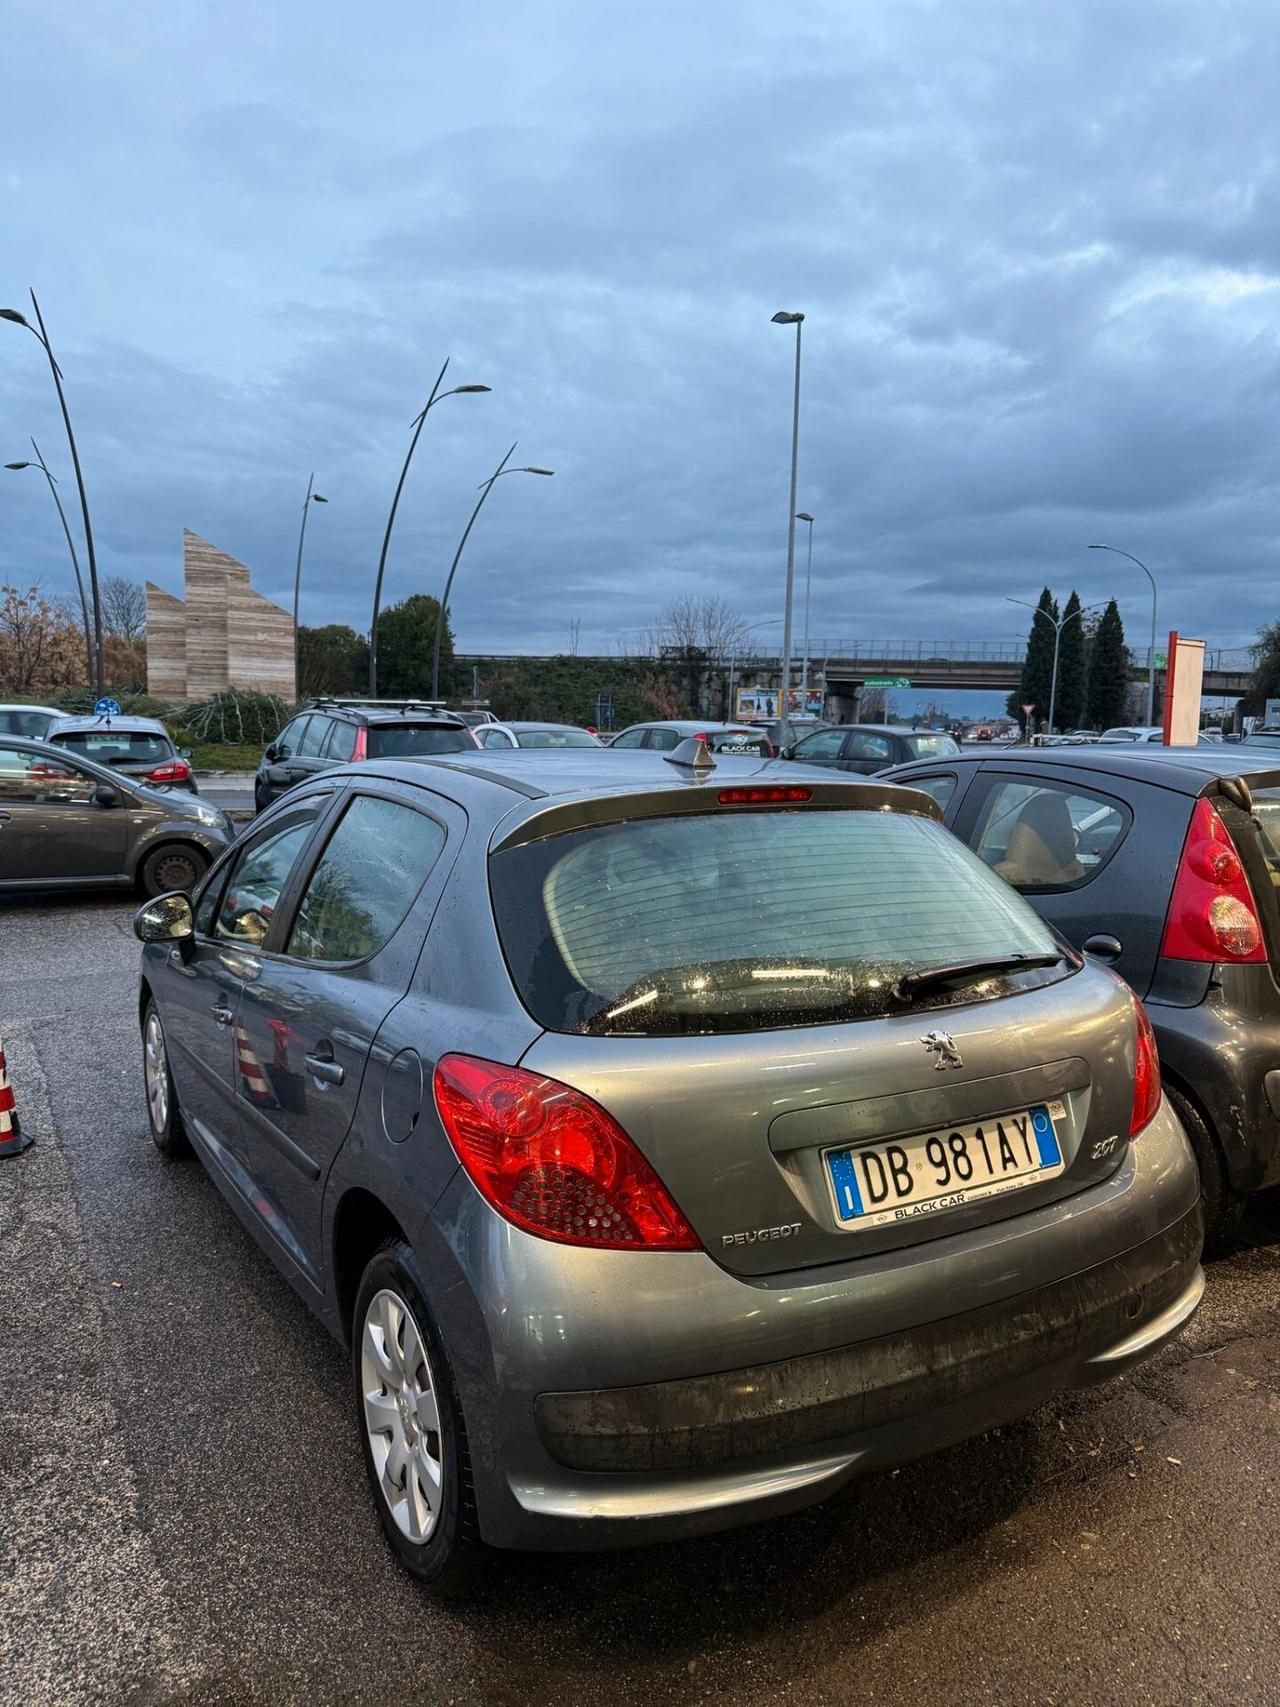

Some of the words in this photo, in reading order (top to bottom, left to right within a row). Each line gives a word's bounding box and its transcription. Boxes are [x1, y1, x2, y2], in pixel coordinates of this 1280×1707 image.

[860, 1145, 914, 1204] DB
[926, 1116, 1034, 1187] 981AY
[1091, 1135, 1119, 1160] 207
[844, 1185, 854, 1210] I
[894, 1201, 938, 1220] BLACK
[939, 1193, 965, 1209] CAR
[721, 1222, 802, 1248] PEUGEOT
